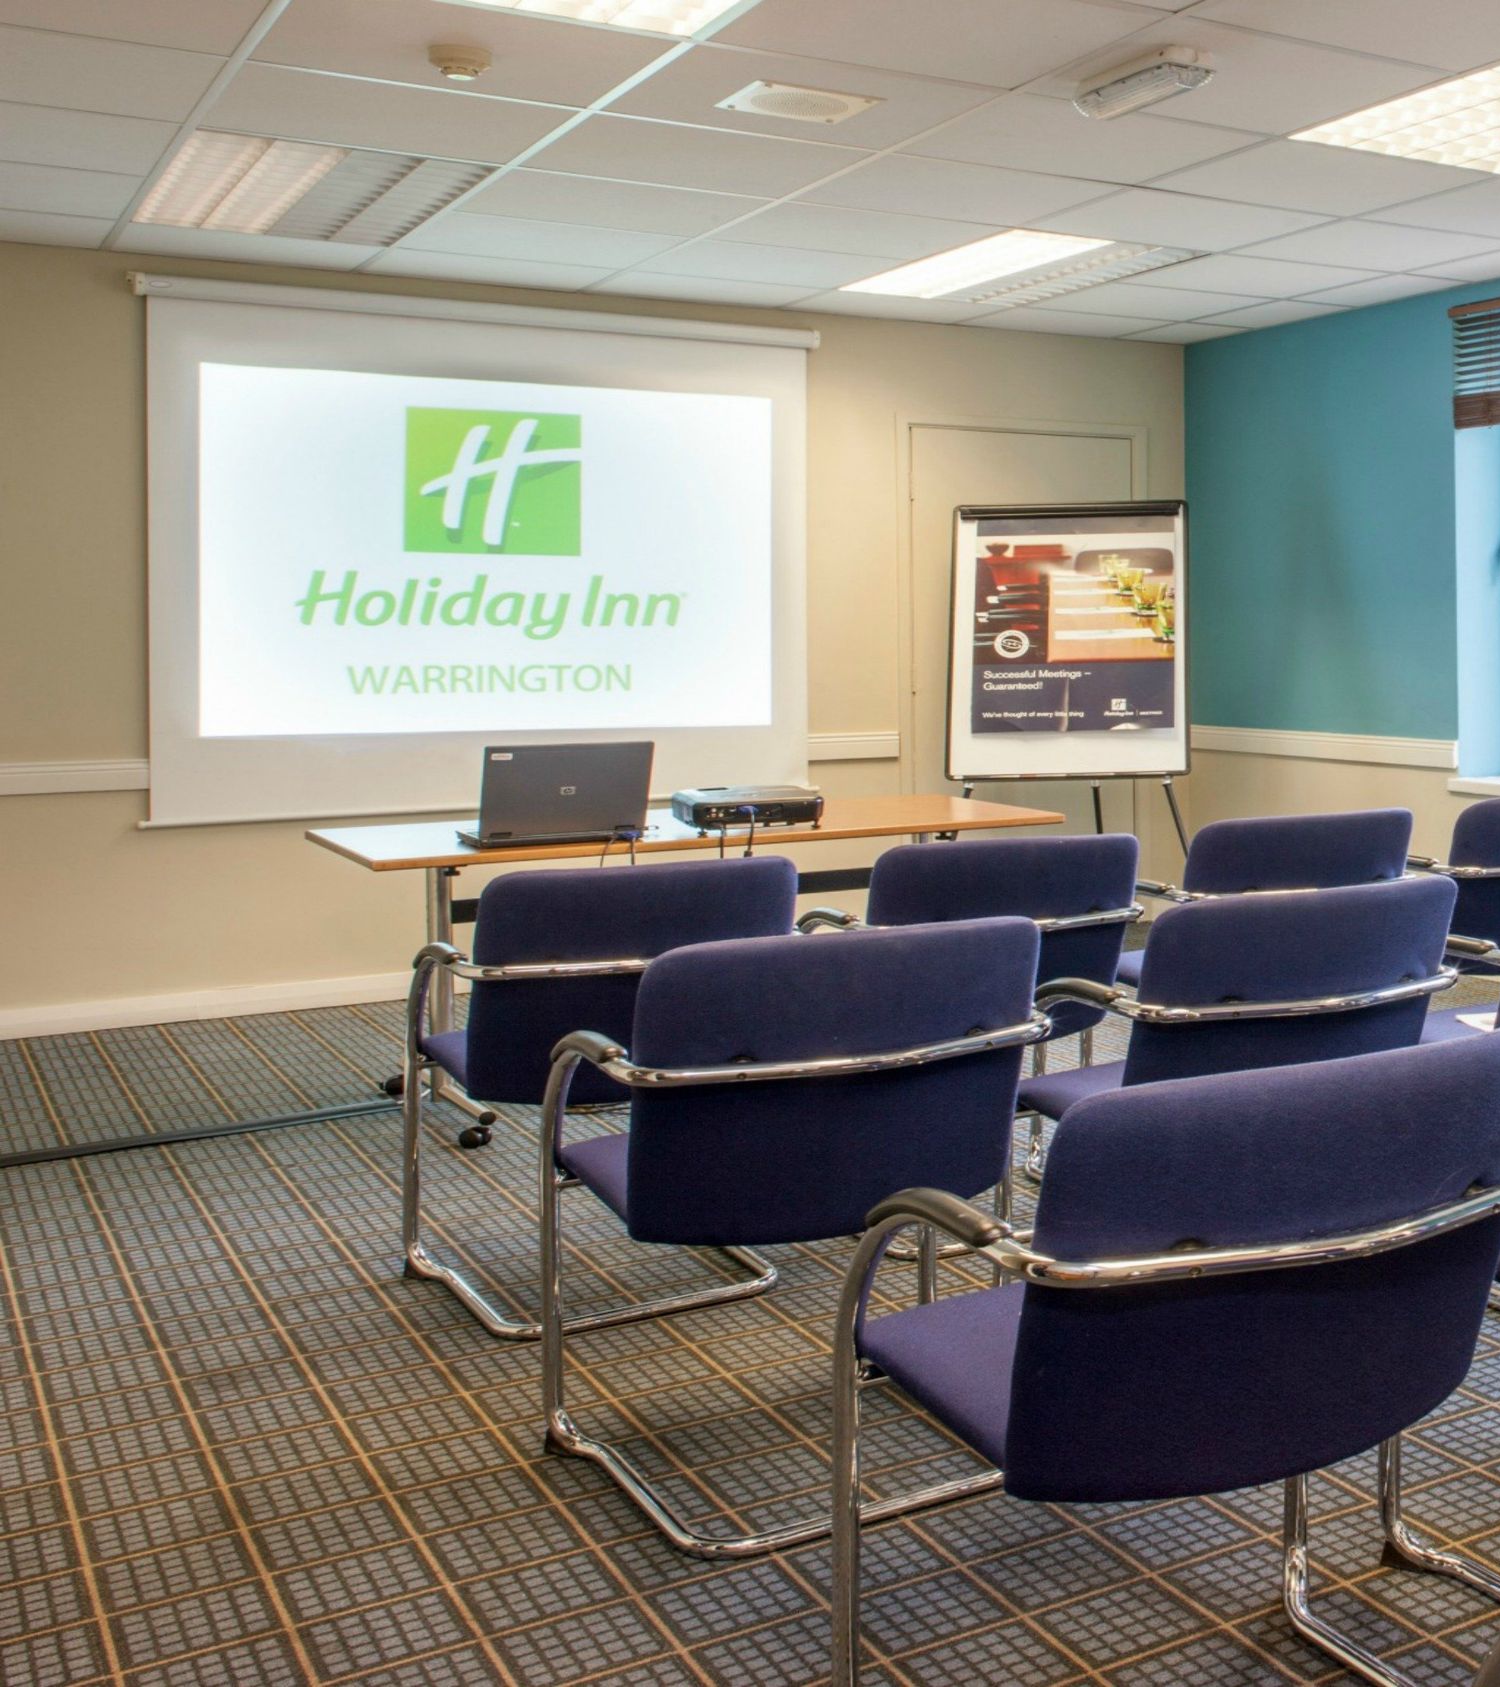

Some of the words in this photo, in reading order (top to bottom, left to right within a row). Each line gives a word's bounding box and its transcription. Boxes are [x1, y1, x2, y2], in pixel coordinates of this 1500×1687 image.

[295, 569, 571, 641] Holiday
[580, 574, 682, 627] Inn
[347, 663, 633, 695] WARRINGTON
[983, 670, 1036, 679] Successful
[1038, 669, 1082, 680] Meetings
[1003, 711, 1027, 719] thought
